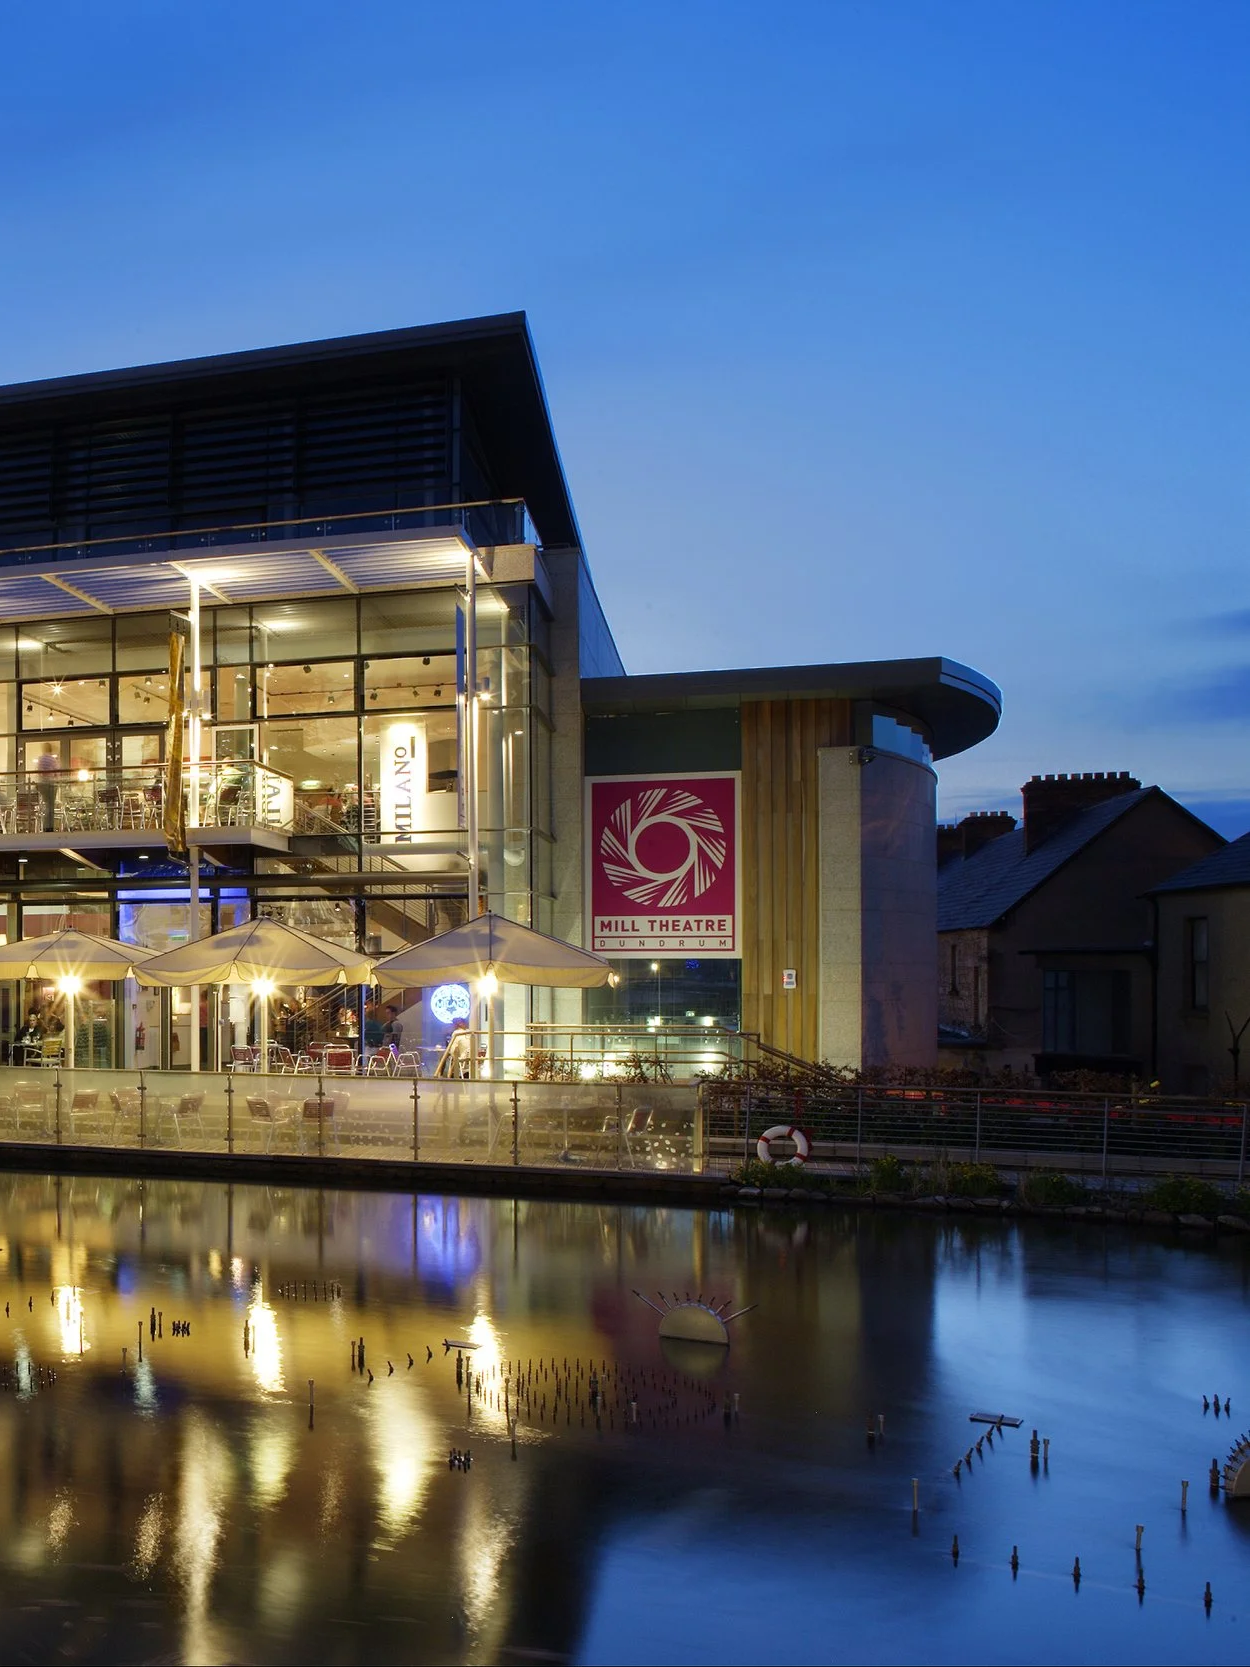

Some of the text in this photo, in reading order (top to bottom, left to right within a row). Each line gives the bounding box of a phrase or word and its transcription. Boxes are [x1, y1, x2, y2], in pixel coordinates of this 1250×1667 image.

[394, 746, 412, 843] MILANO
[600, 919, 727, 932] MILL THEATRE
[599, 939, 727, 947] DUNDRUM
